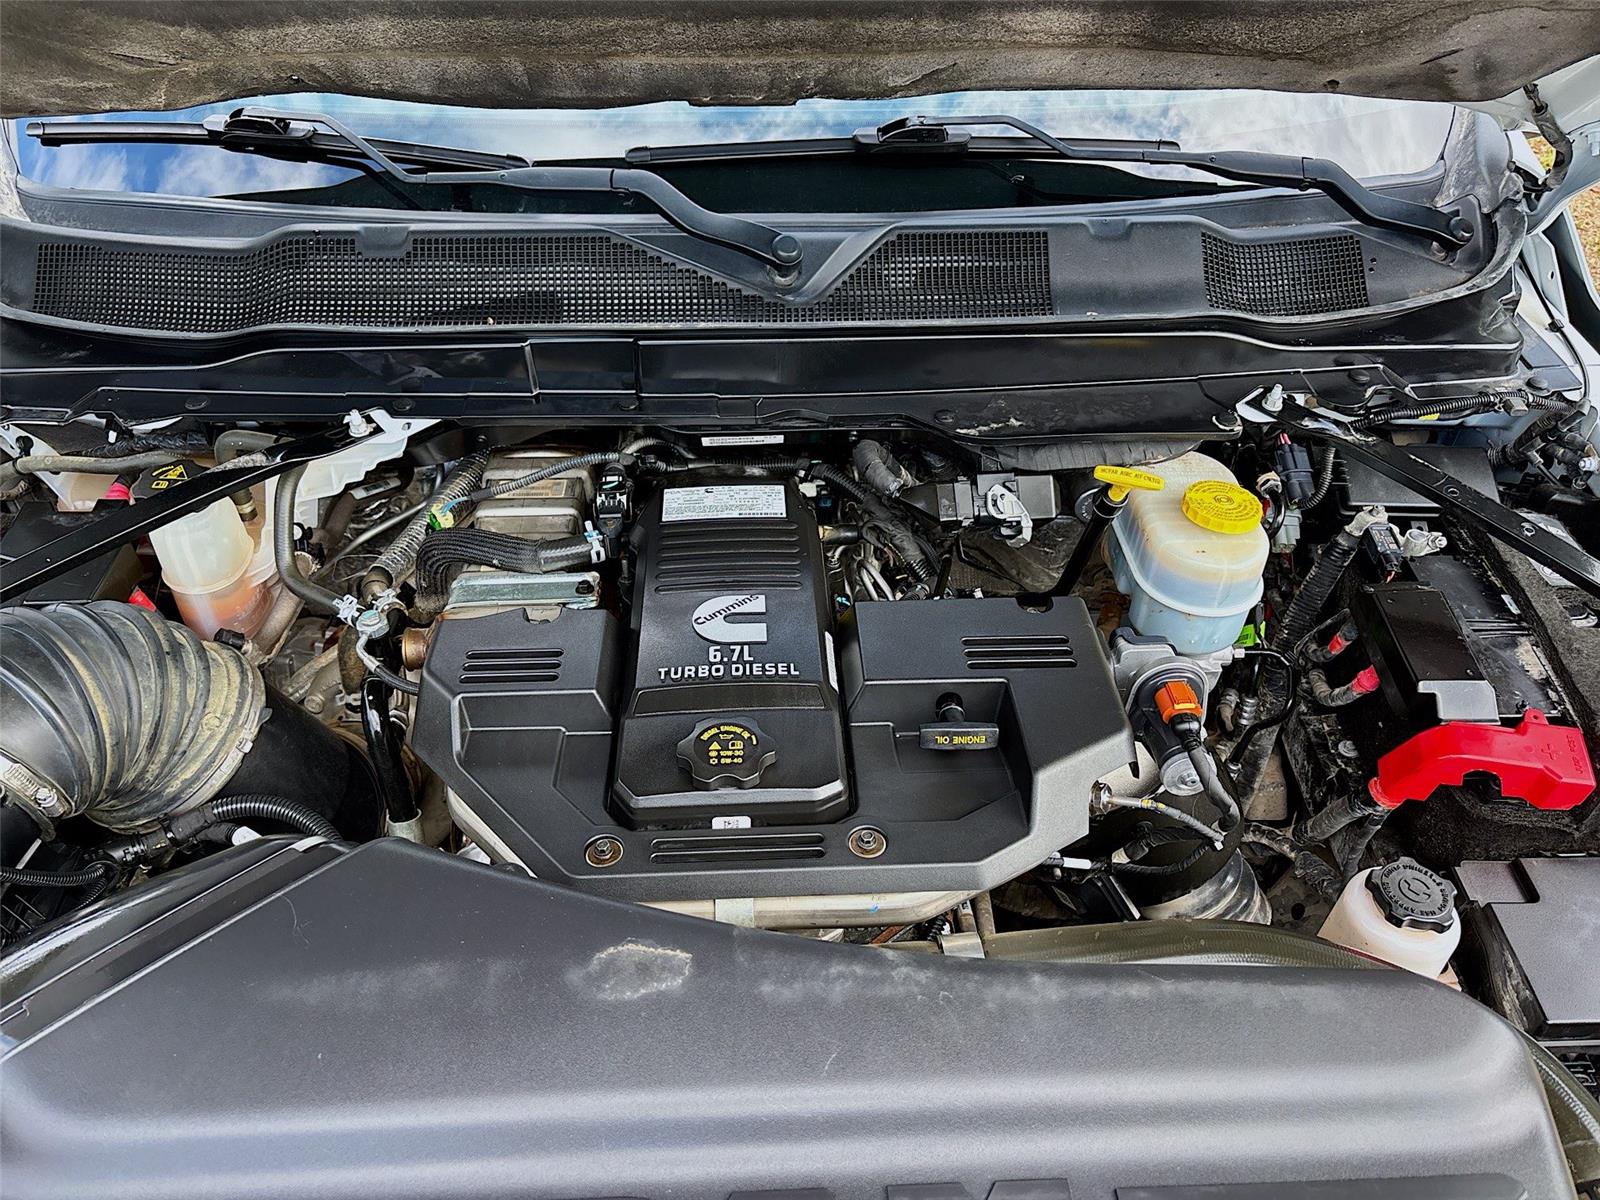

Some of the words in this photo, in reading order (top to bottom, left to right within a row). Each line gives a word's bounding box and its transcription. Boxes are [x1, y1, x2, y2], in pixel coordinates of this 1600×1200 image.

[694, 594, 760, 625] Cummins
[708, 645, 754, 663] 6.7L
[658, 664, 725, 680] TURBO
[731, 662, 800, 676] DIESEL
[935, 735, 950, 744] OIL
[952, 735, 986, 745] ENGINE
